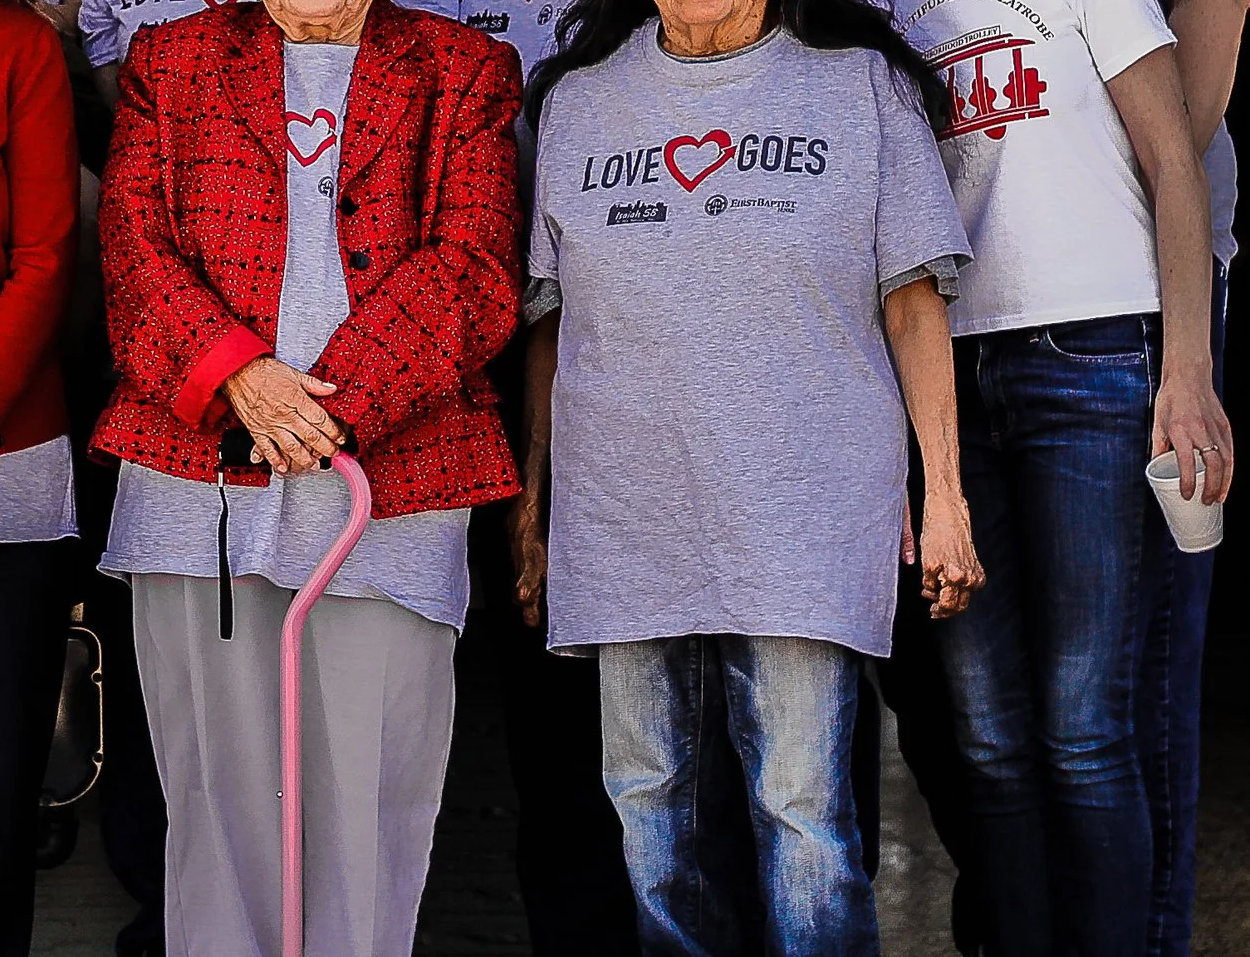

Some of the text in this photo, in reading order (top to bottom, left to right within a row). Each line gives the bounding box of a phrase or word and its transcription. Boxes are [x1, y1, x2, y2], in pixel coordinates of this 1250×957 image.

[964, 27, 999, 43] TROLLEY
[581, 133, 829, 193] LOVE GOES
